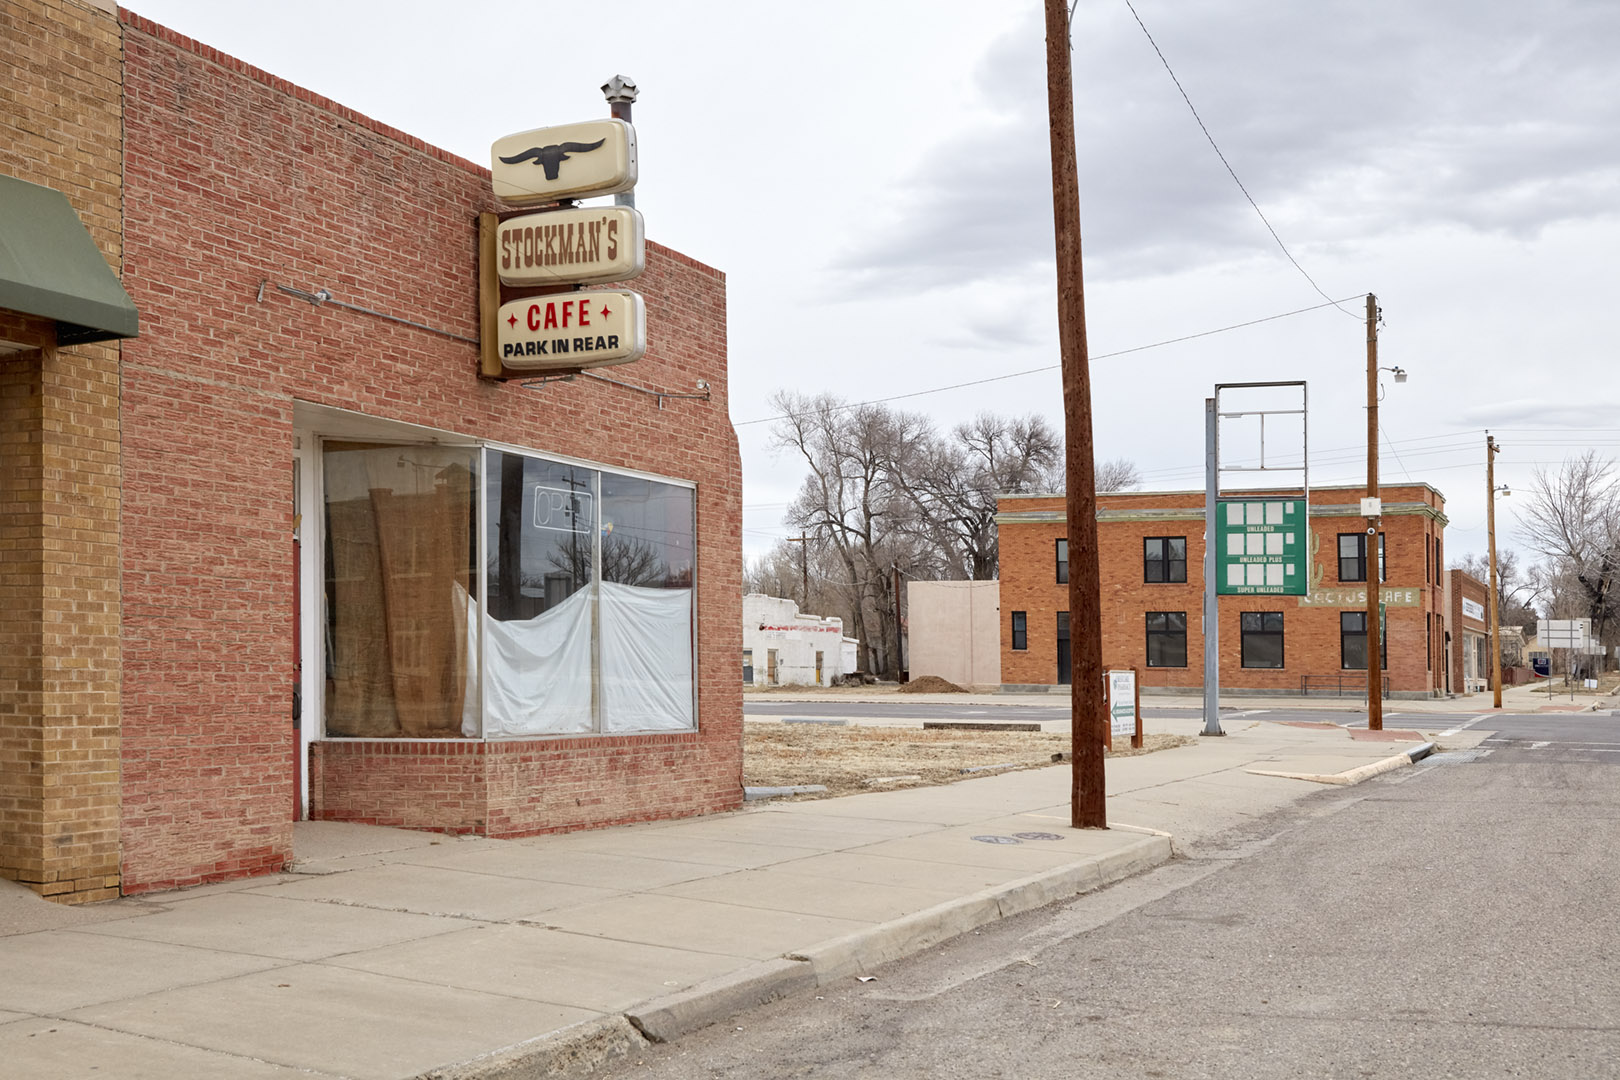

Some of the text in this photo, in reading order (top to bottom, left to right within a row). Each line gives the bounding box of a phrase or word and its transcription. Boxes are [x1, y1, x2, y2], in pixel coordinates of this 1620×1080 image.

[502, 216, 617, 269] STOCKMAN'S
[527, 299, 590, 332] CAFE
[503, 335, 619, 357] PARK IN REAR
